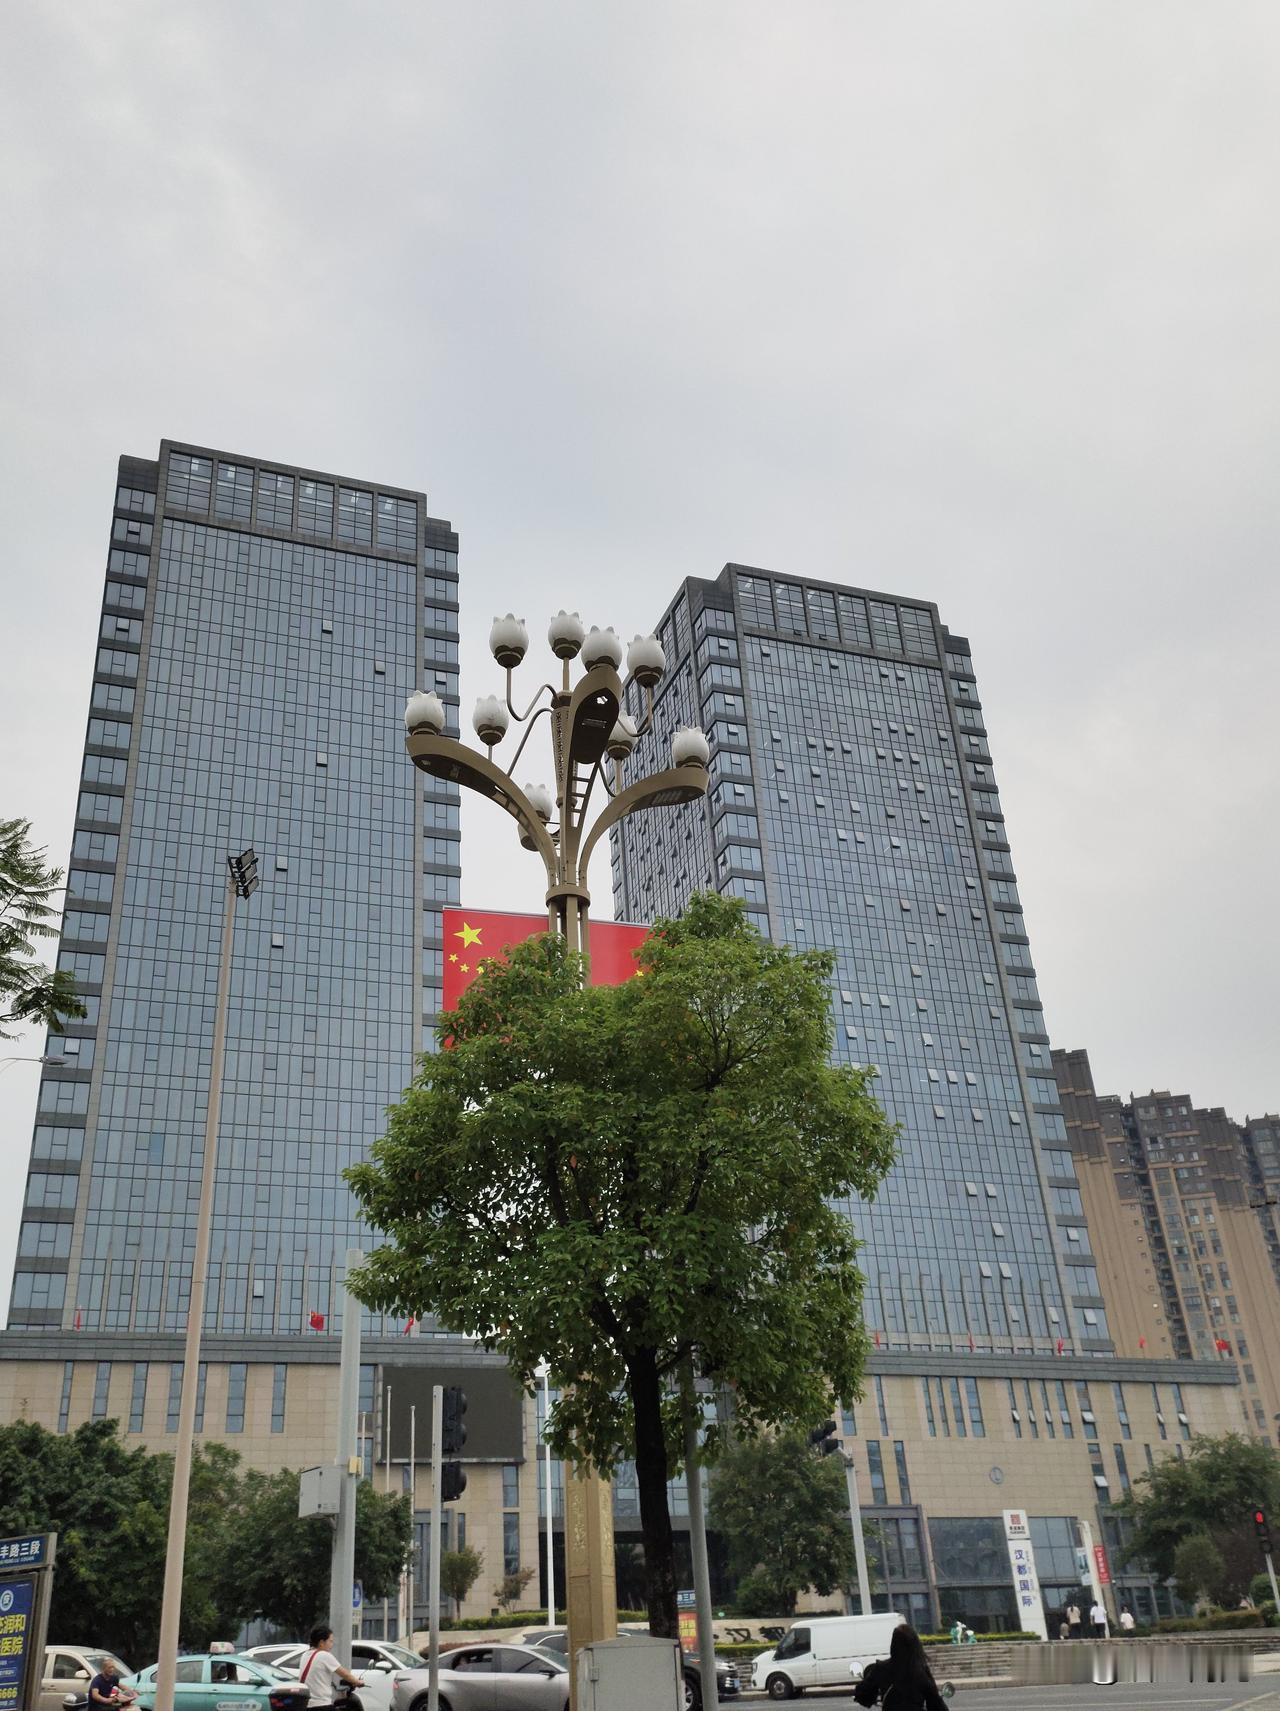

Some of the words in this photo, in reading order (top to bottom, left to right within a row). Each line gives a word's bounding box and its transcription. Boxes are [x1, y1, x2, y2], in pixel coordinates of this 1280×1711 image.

[1015, 1549, 1032, 1607] 汉都国际
[0, 1635, 24, 1656] 医院
